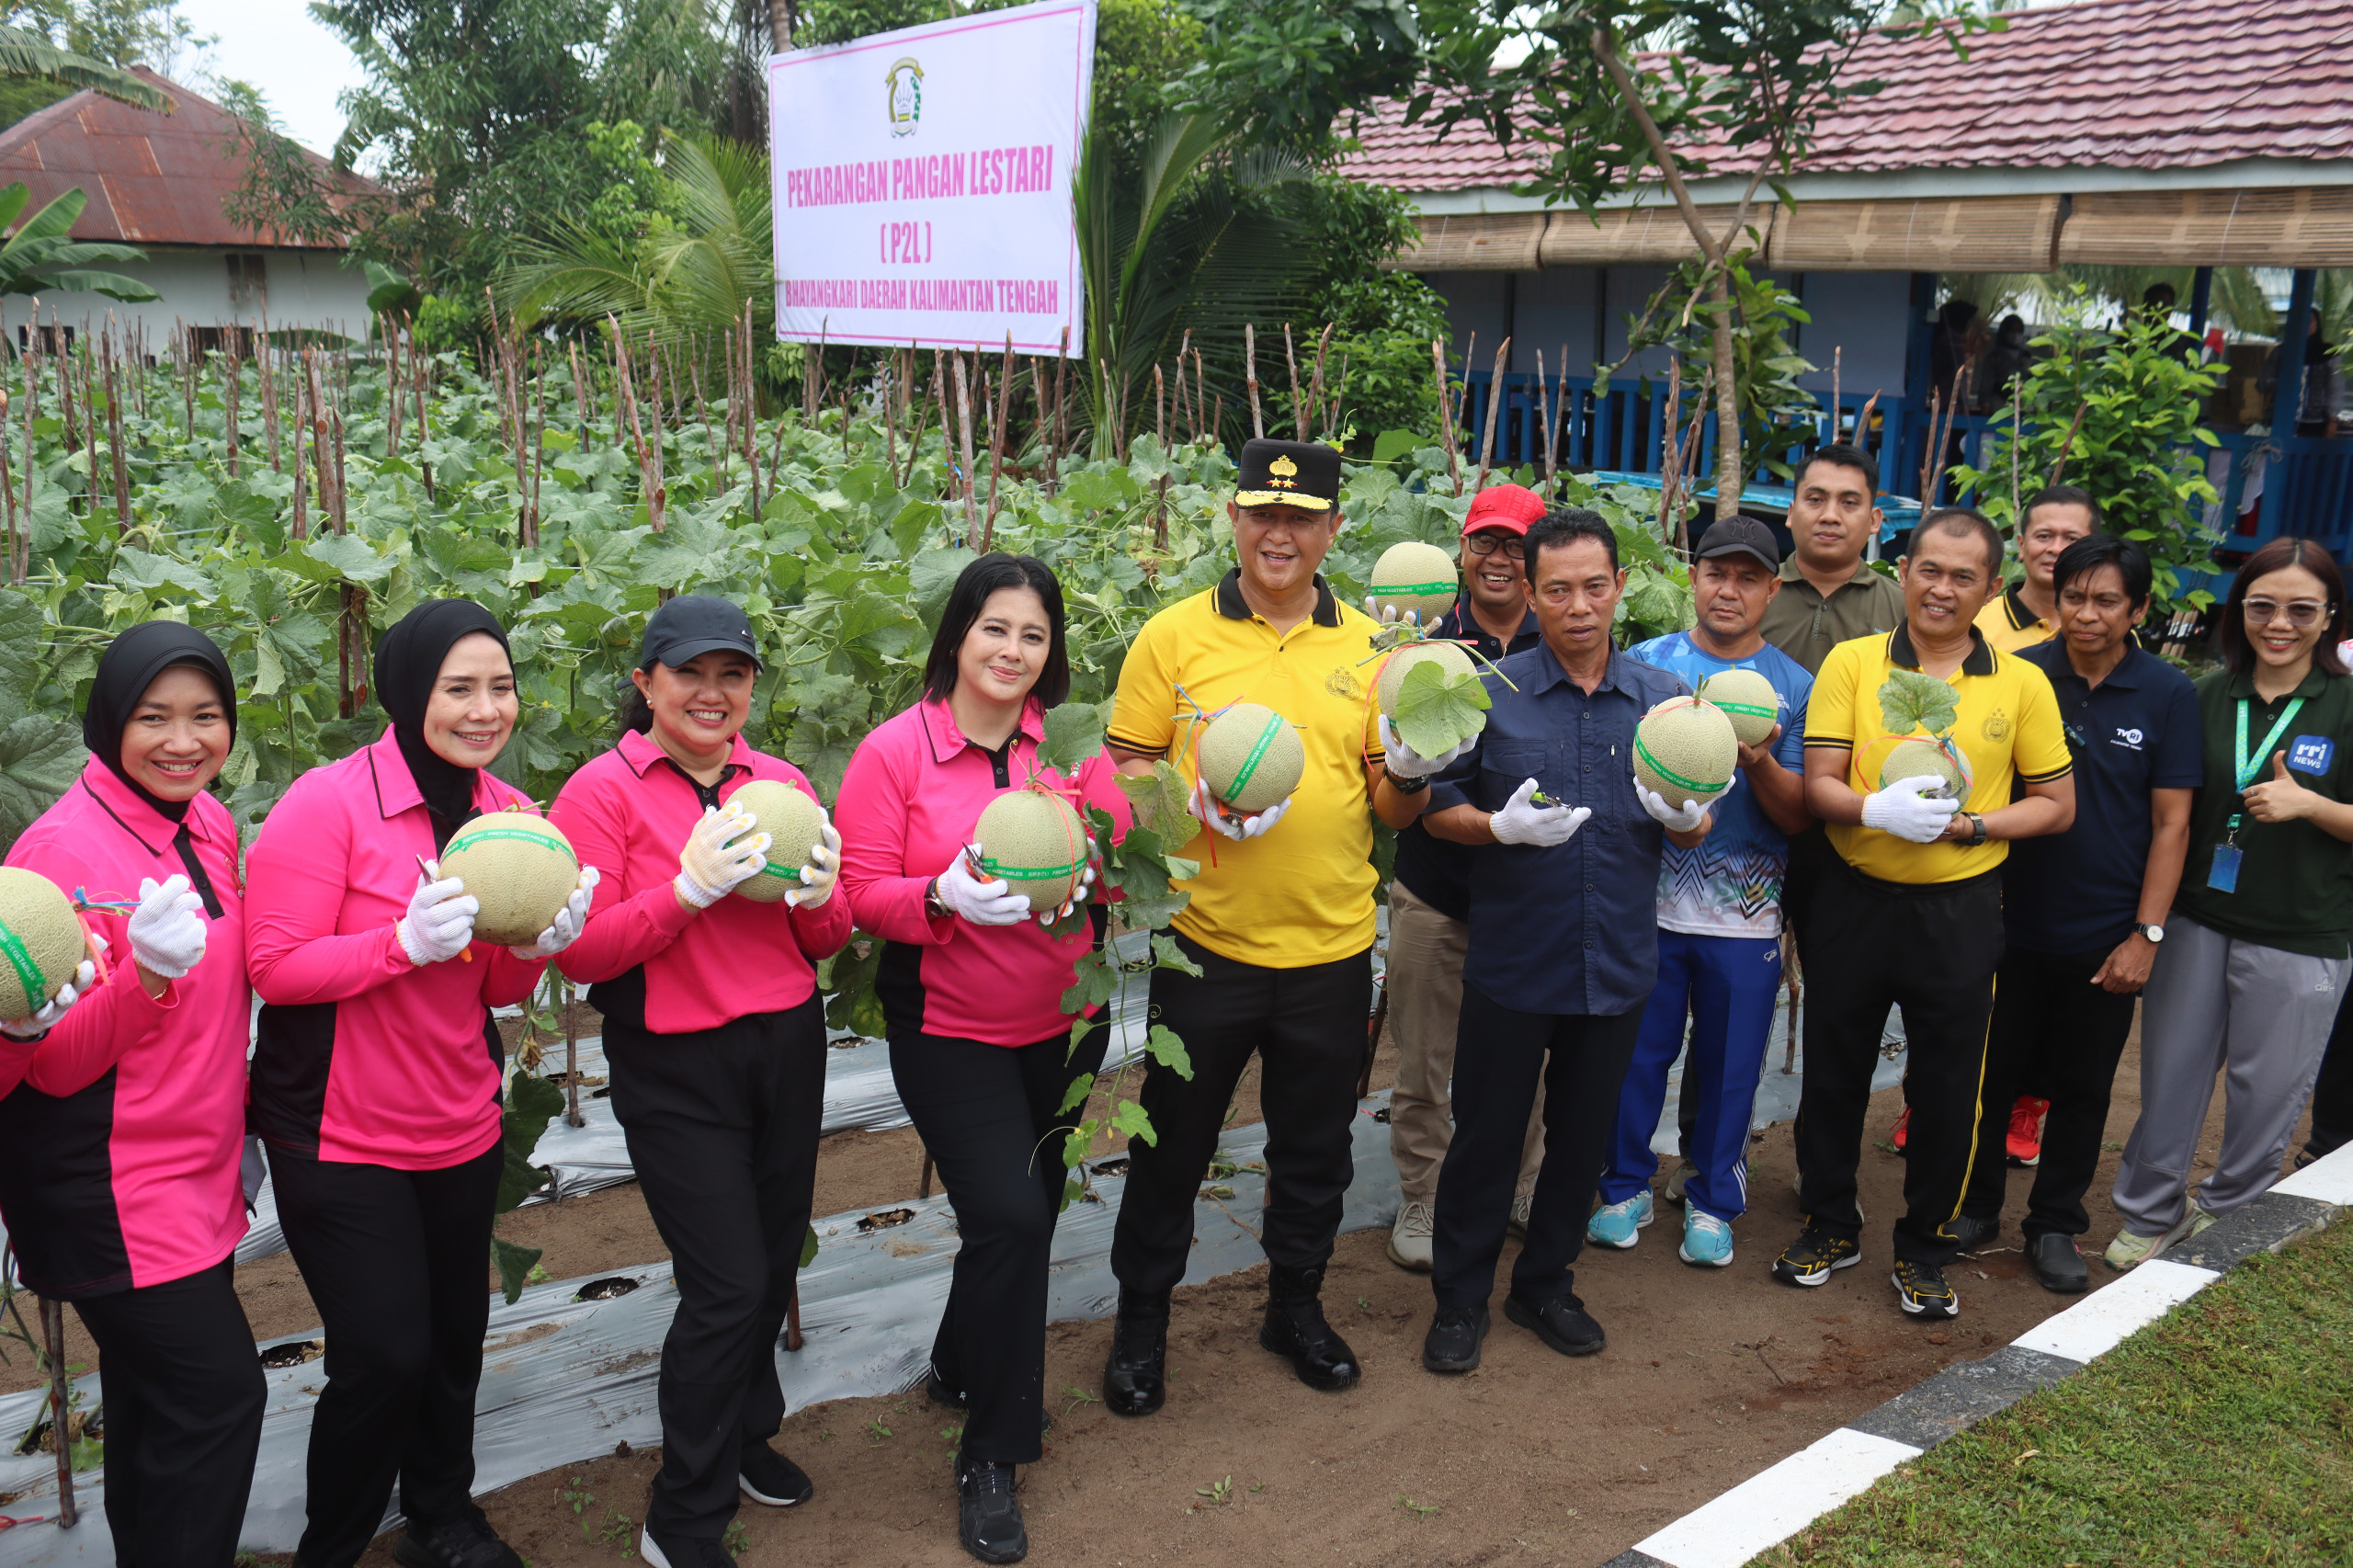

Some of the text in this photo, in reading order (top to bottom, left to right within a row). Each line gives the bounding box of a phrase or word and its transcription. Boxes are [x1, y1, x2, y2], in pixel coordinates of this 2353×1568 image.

[787, 144, 1053, 209] PEKARANGAN PANGAN LESTARI
[785, 279, 1058, 314] BHAYANGKARI DAERAH KALIMANTAN TENGAH
[2116, 727, 2143, 744] TVRI
[1240, 734, 1269, 779] FRESH VEGETABLES
[2293, 756, 2322, 769] NEWS
[2296, 743, 2327, 760] rri
[1648, 759, 1662, 773] FRESH
[1662, 769, 1692, 788] VEGETABLES
[509, 831, 549, 844] VEGETABLES
[992, 869, 1023, 877] VEGETABLES
[6, 941, 38, 981] VEGETABLES
